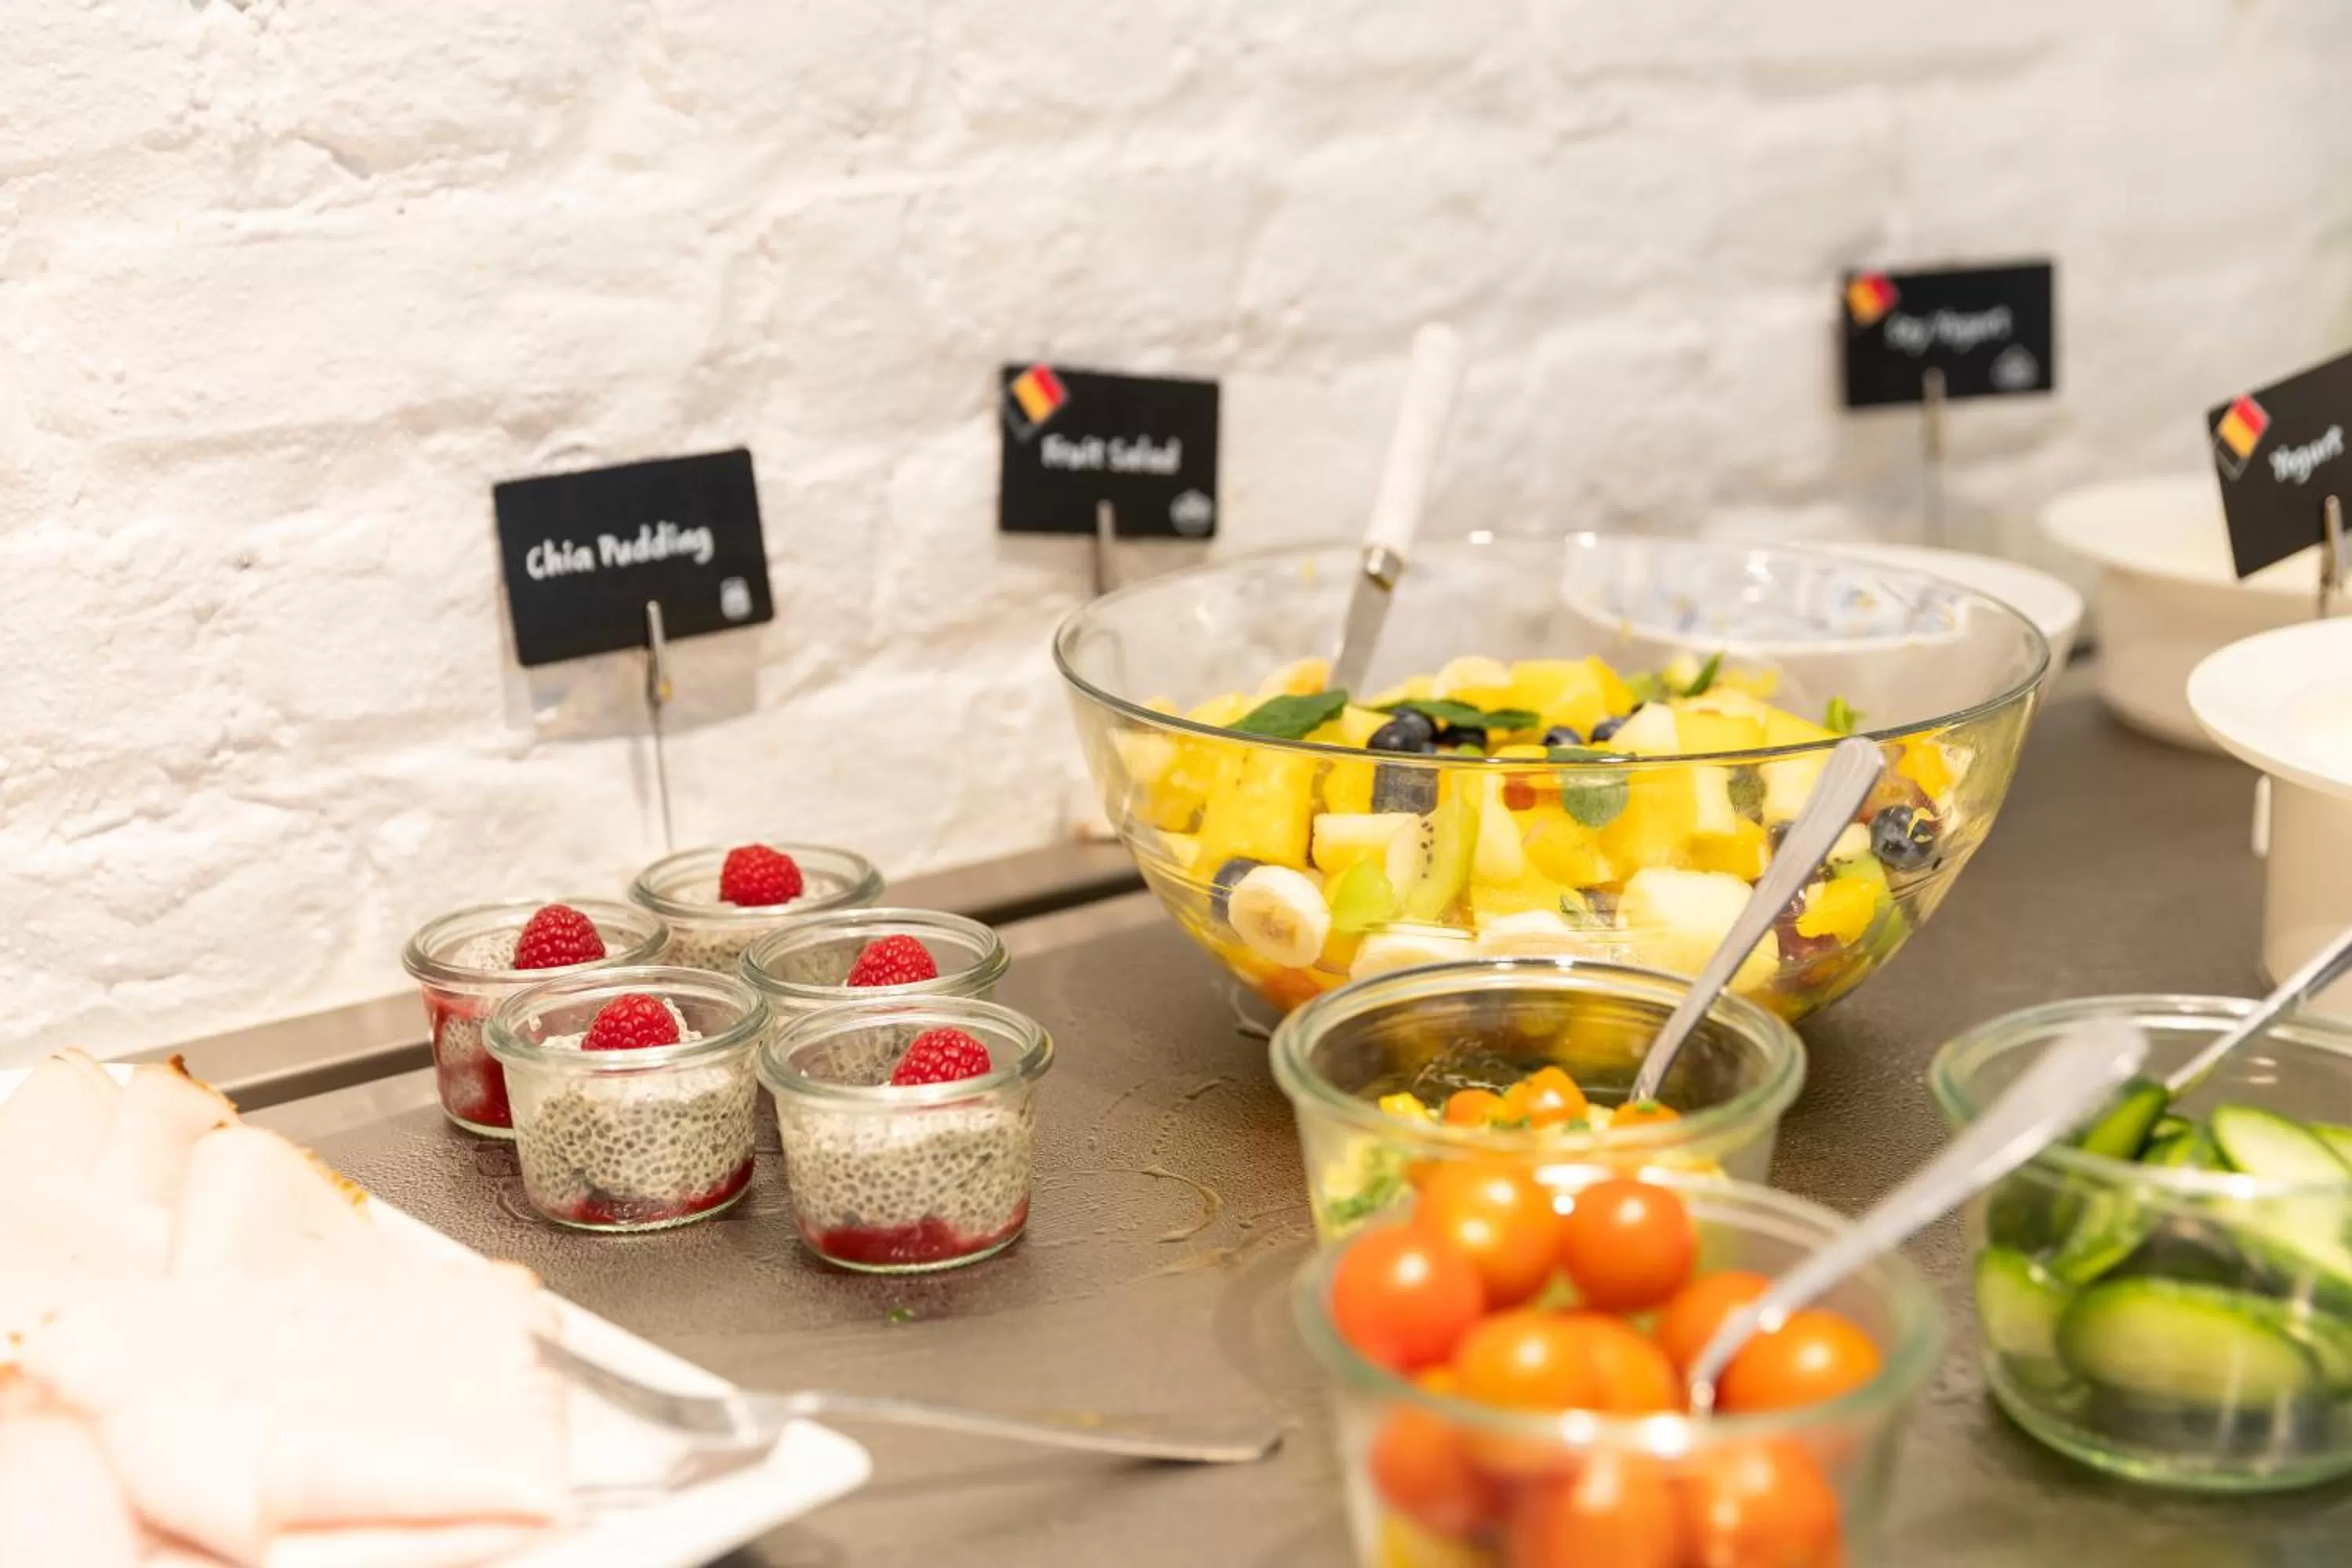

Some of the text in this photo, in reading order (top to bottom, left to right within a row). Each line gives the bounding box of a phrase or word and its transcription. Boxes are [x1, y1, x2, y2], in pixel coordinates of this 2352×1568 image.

[1041, 434, 1182, 474] Fruit Salad
[2269, 424, 2344, 485] Yogurt
[526, 521, 715, 579] Chia Pudding
